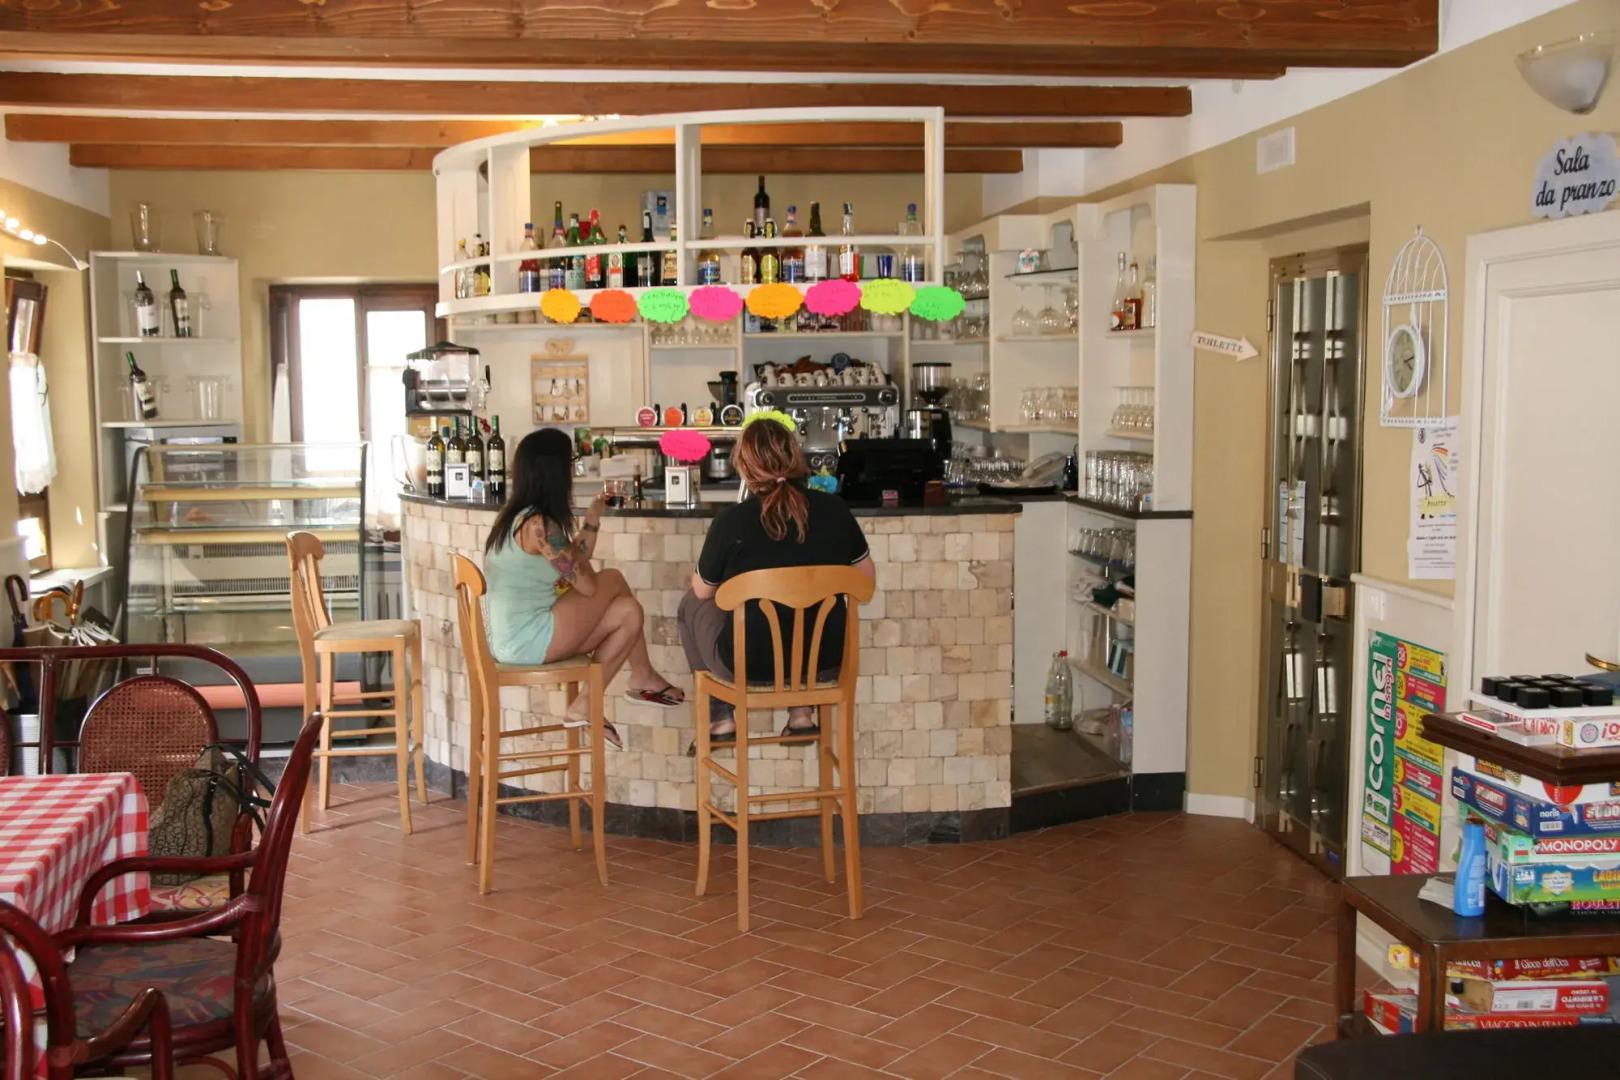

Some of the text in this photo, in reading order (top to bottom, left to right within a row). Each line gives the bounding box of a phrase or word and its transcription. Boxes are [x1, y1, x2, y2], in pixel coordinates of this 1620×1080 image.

[1554, 146, 1590, 176] Sala
[1536, 179, 1616, 211] da pranzo
[1197, 335, 1244, 353] TOILETTE
[1540, 808, 1559, 818] noris
[1540, 839, 1618, 852] MONOPOLY
[1520, 958, 1541, 969] Gioco
